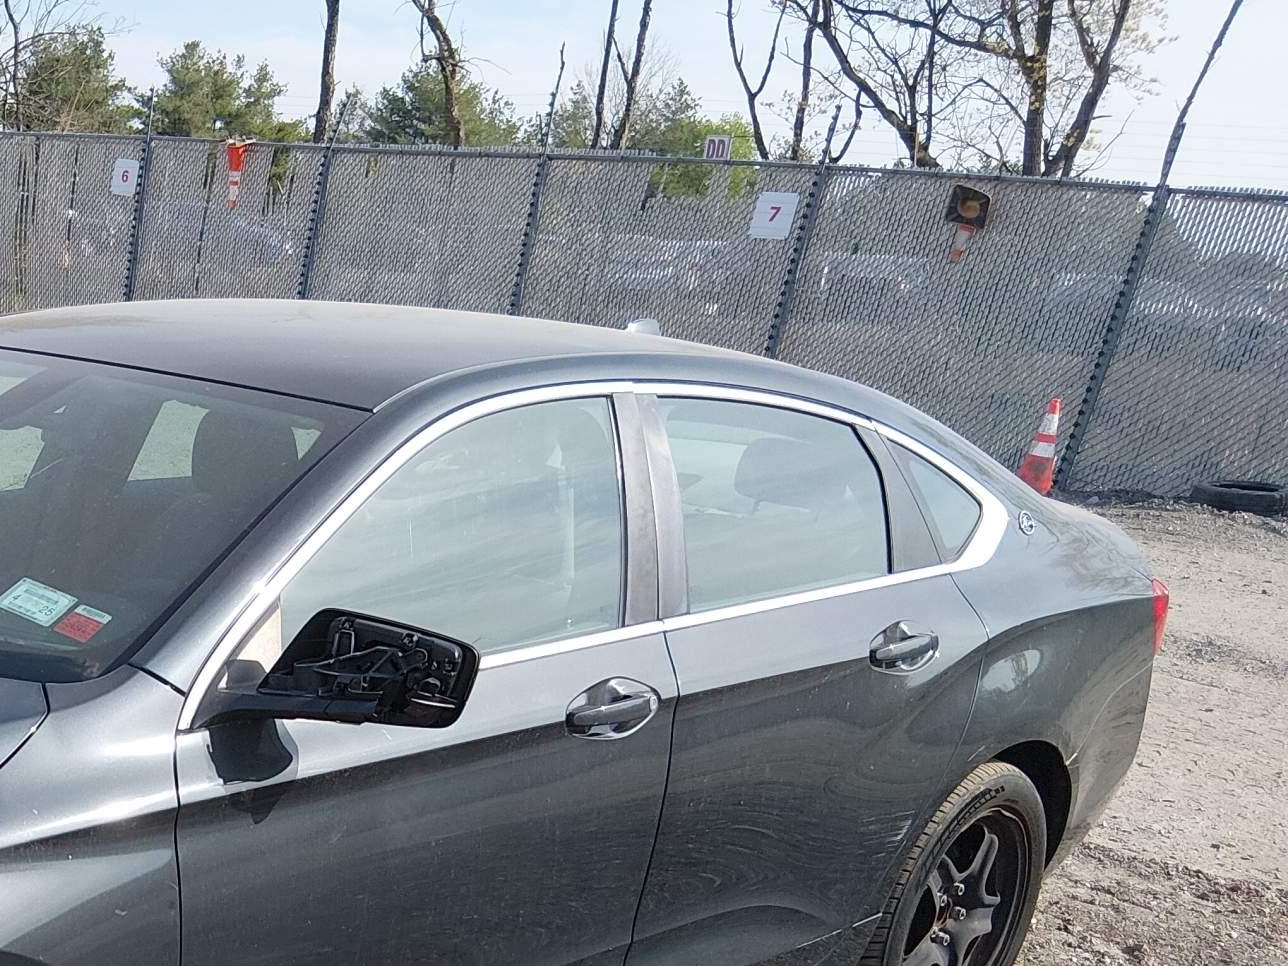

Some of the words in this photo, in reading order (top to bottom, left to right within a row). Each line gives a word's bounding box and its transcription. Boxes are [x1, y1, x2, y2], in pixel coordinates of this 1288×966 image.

[706, 139, 726, 159] DD
[122, 170, 129, 183] 6
[768, 206, 782, 222] 7
